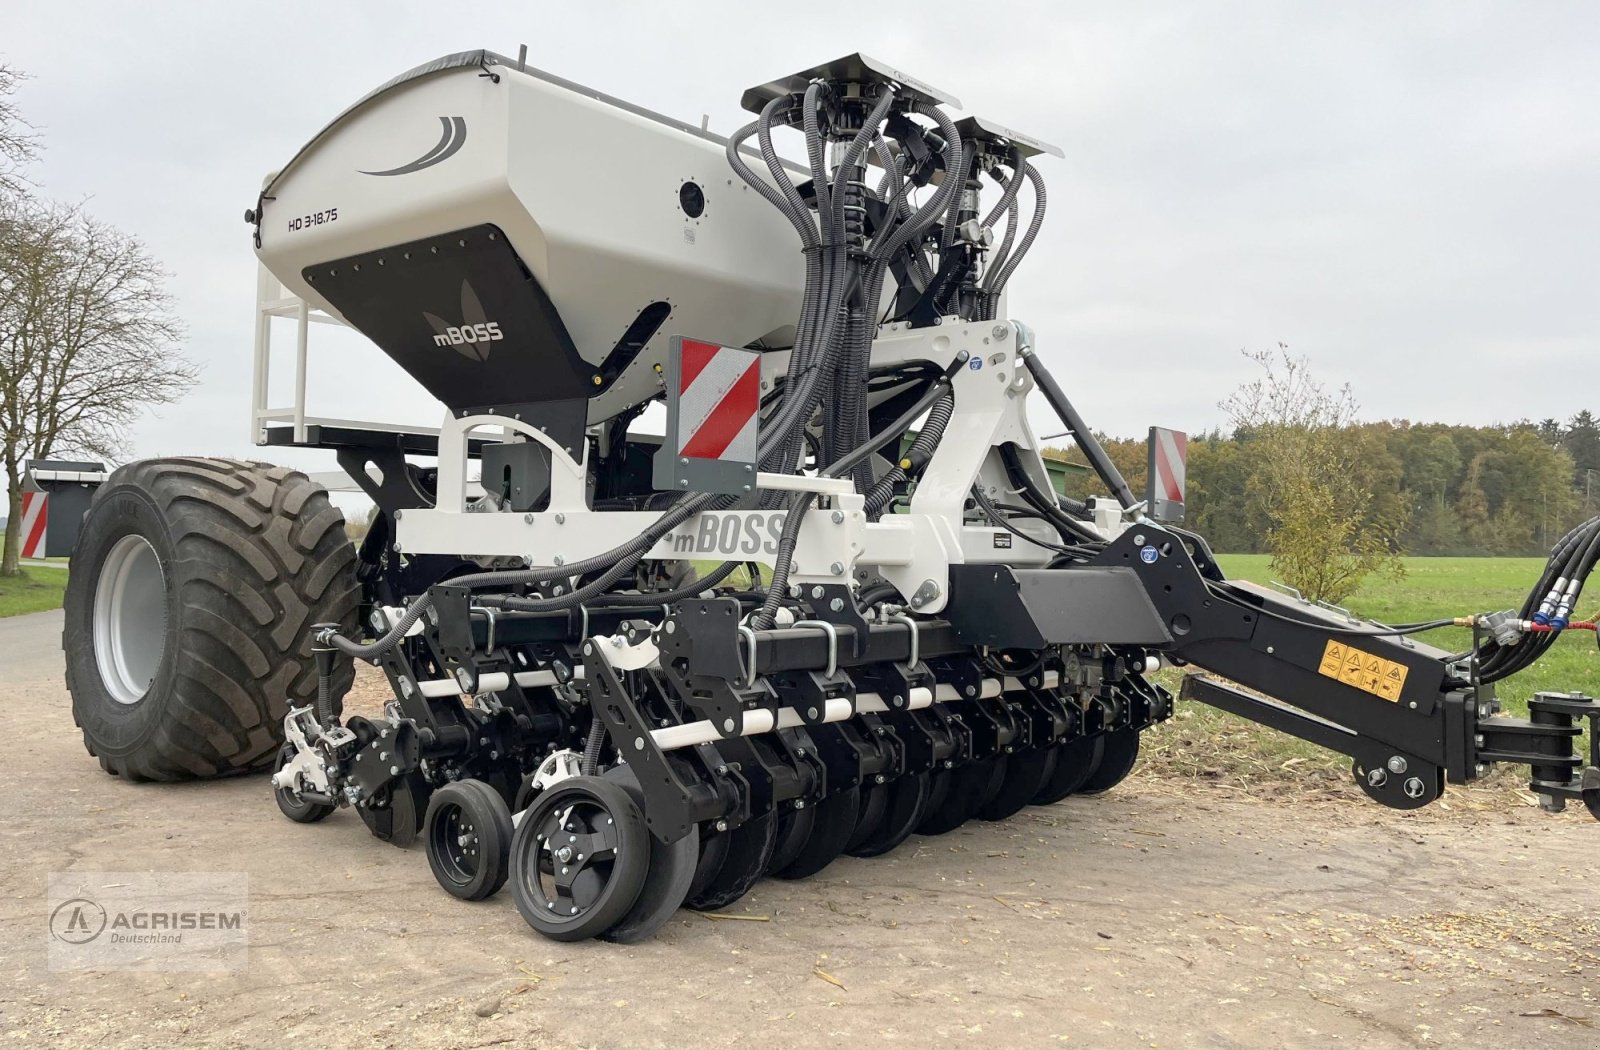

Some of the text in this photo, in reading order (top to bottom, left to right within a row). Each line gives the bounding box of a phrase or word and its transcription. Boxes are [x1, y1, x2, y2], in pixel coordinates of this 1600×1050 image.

[288, 207, 338, 233] HD 3-18.75
[432, 321, 504, 347] mBOSS
[673, 513, 787, 555] mBOSS
